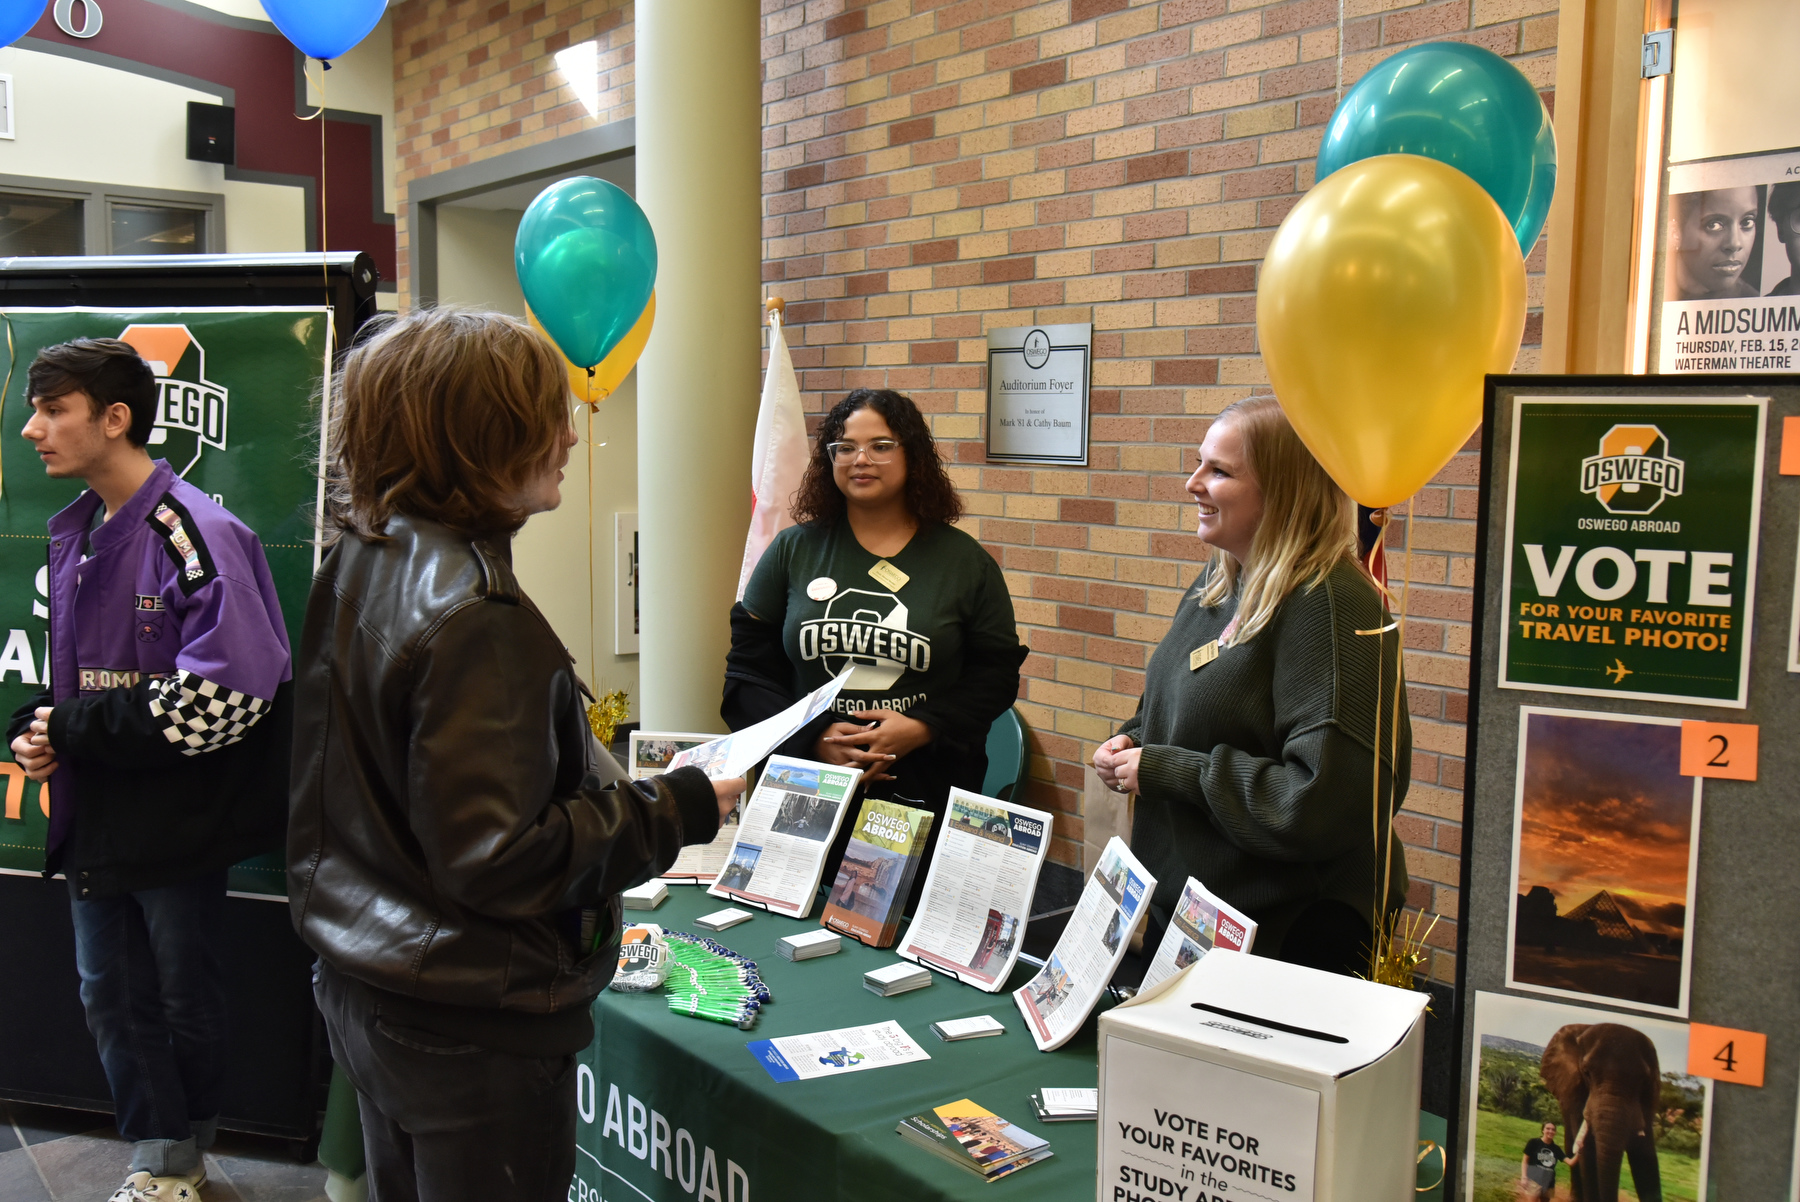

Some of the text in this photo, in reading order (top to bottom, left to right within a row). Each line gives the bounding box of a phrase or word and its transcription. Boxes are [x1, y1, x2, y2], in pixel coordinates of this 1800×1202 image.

[1677, 310, 1690, 336] A
[1676, 340, 1737, 355] THURSDAY,
[1740, 339, 1766, 352] FEB.
[1769, 338, 1788, 353] 15,
[1675, 356, 1791, 370] WATERMAN THEATRE
[999, 379, 1074, 393] Auditorium Foyer
[156, 382, 224, 445] EGO
[1000, 418, 1016, 427] Mark
[1026, 419, 1032, 427] &
[1034, 419, 1051, 429] Cathy
[1053, 420, 1072, 428] Baum
[1583, 457, 1680, 494] OSWEGO
[1578, 518, 1681, 533] OSWEGO ABROAD
[1522, 543, 1733, 607] VOTE
[1520, 602, 1732, 629] FOR YOUR FAVORITE
[799, 623, 931, 672] OSWEGO
[1519, 620, 1729, 653] TRAVEL PHOTO!
[1706, 734, 1730, 768] 2
[822, 779, 848, 787] ABROAD
[824, 773, 850, 783] OSWEGO
[862, 822, 907, 844] ABROAD
[867, 811, 911, 832] OSWEGO
[954, 820, 978, 834] England
[979, 828, 984, 836] &
[985, 830, 1006, 844] Ireland
[1013, 825, 1041, 837] ABROAD
[1014, 817, 1042, 831] OSWEGO
[1218, 926, 1242, 947] ABROAD
[1221, 918, 1244, 939] OSWEGO
[619, 944, 659, 962] SWEGO
[1713, 1040, 1738, 1072] 4
[910, 1116, 948, 1139] Scholarships
[1153, 1108, 1260, 1156] VOTE FOR
[602, 1082, 749, 1202] ABROAD
[1118, 1121, 1296, 1192] YOUR FAVORITES
[1119, 1165, 1189, 1202] STUDY
[1180, 1164, 1228, 1192] in the
